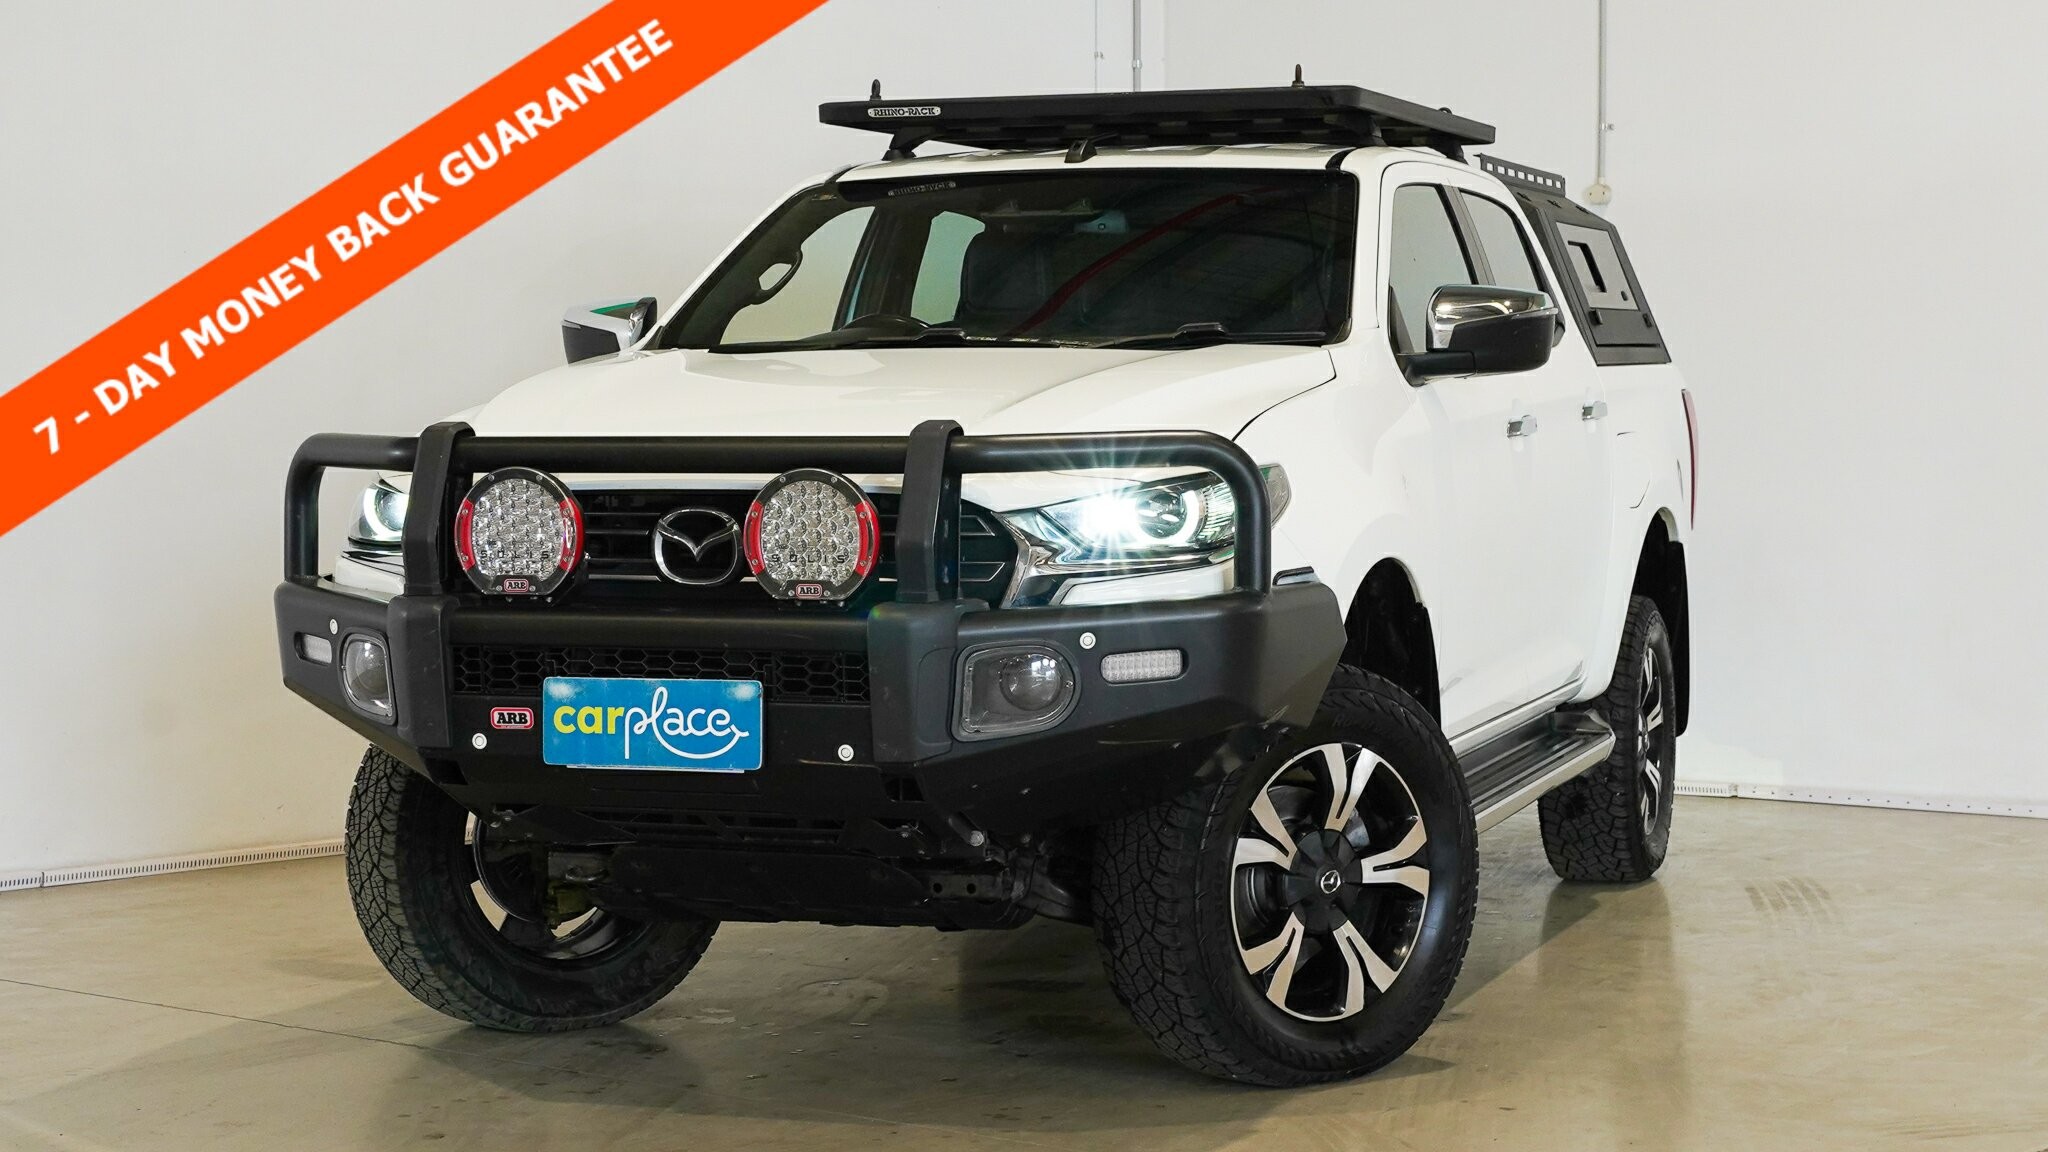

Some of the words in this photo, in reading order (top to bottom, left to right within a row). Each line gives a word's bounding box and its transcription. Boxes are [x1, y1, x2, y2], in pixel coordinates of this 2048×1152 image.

[873, 107, 936, 116] RHINO-RACK
[799, 587, 820, 595] ARB
[496, 711, 528, 725] ARB
[553, 686, 749, 760] carplace
